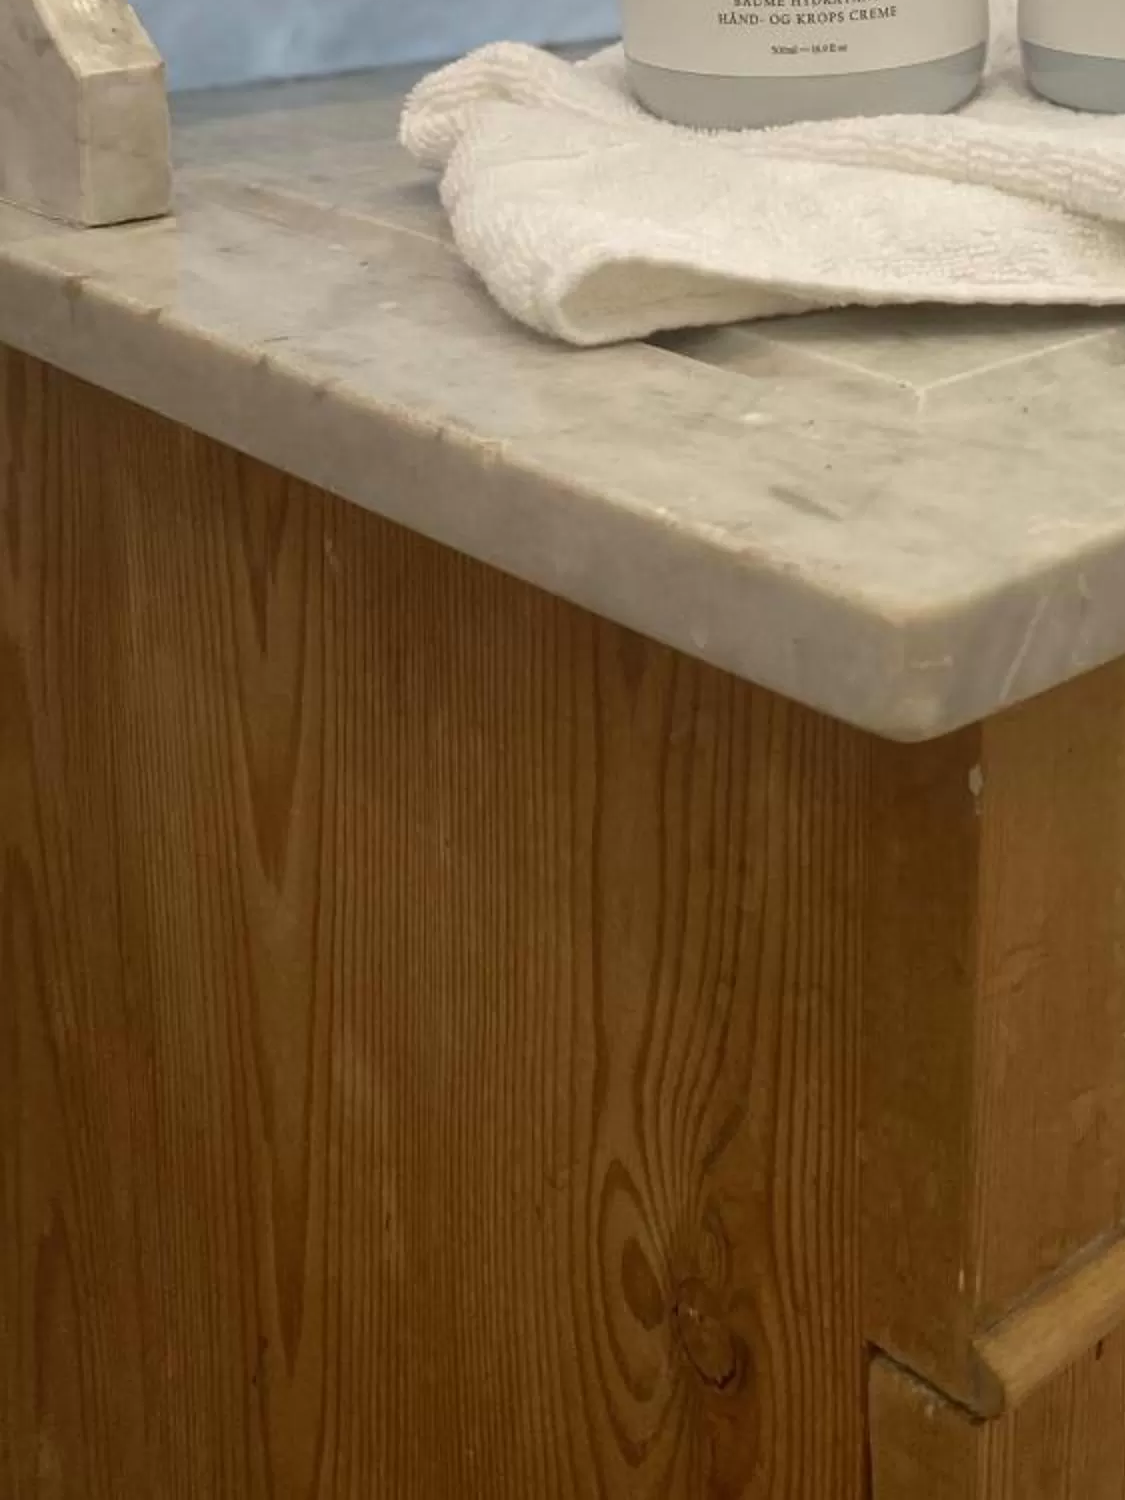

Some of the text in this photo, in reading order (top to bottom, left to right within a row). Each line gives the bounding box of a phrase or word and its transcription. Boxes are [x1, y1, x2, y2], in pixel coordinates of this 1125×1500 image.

[769, 13, 791, 25] OG
[795, 11, 845, 25] KROPS
[848, 5, 897, 21] CREME
